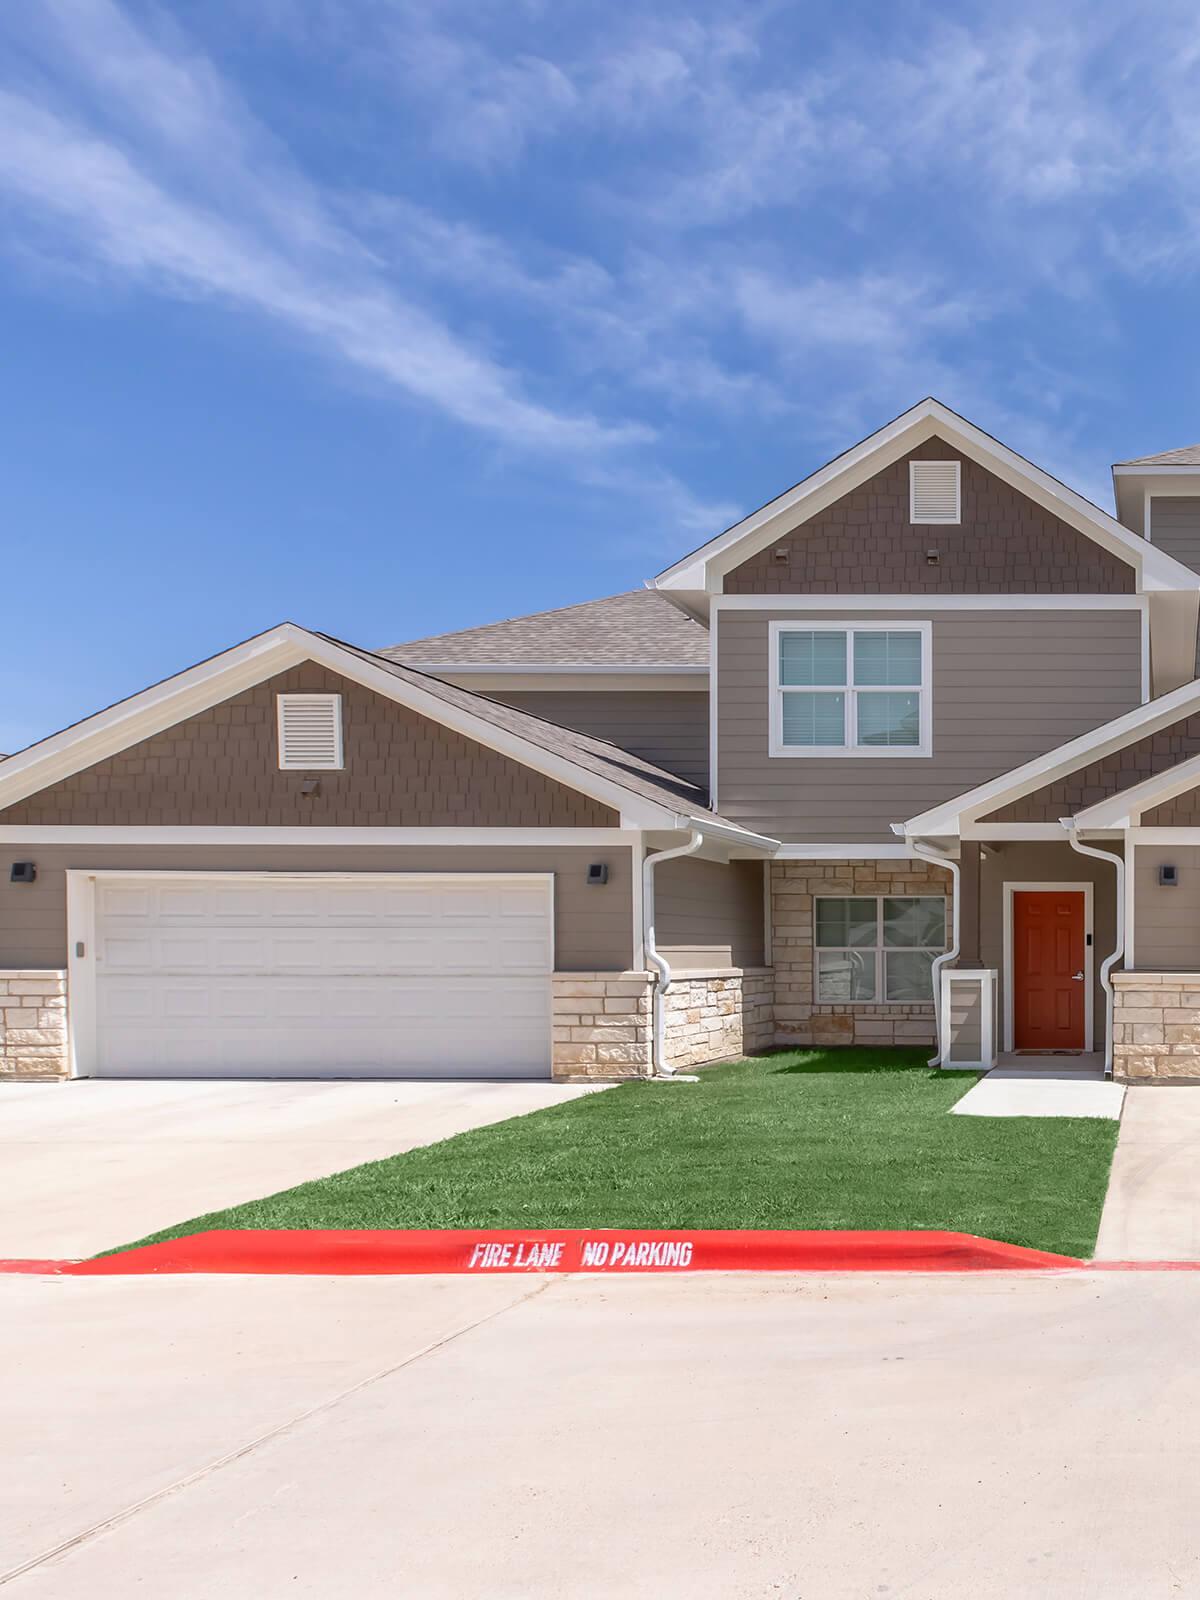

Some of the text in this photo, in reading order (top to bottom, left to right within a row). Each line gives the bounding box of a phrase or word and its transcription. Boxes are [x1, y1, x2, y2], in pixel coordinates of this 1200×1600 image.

[468, 1241, 693, 1267] FIRE LANE NO PARKING
